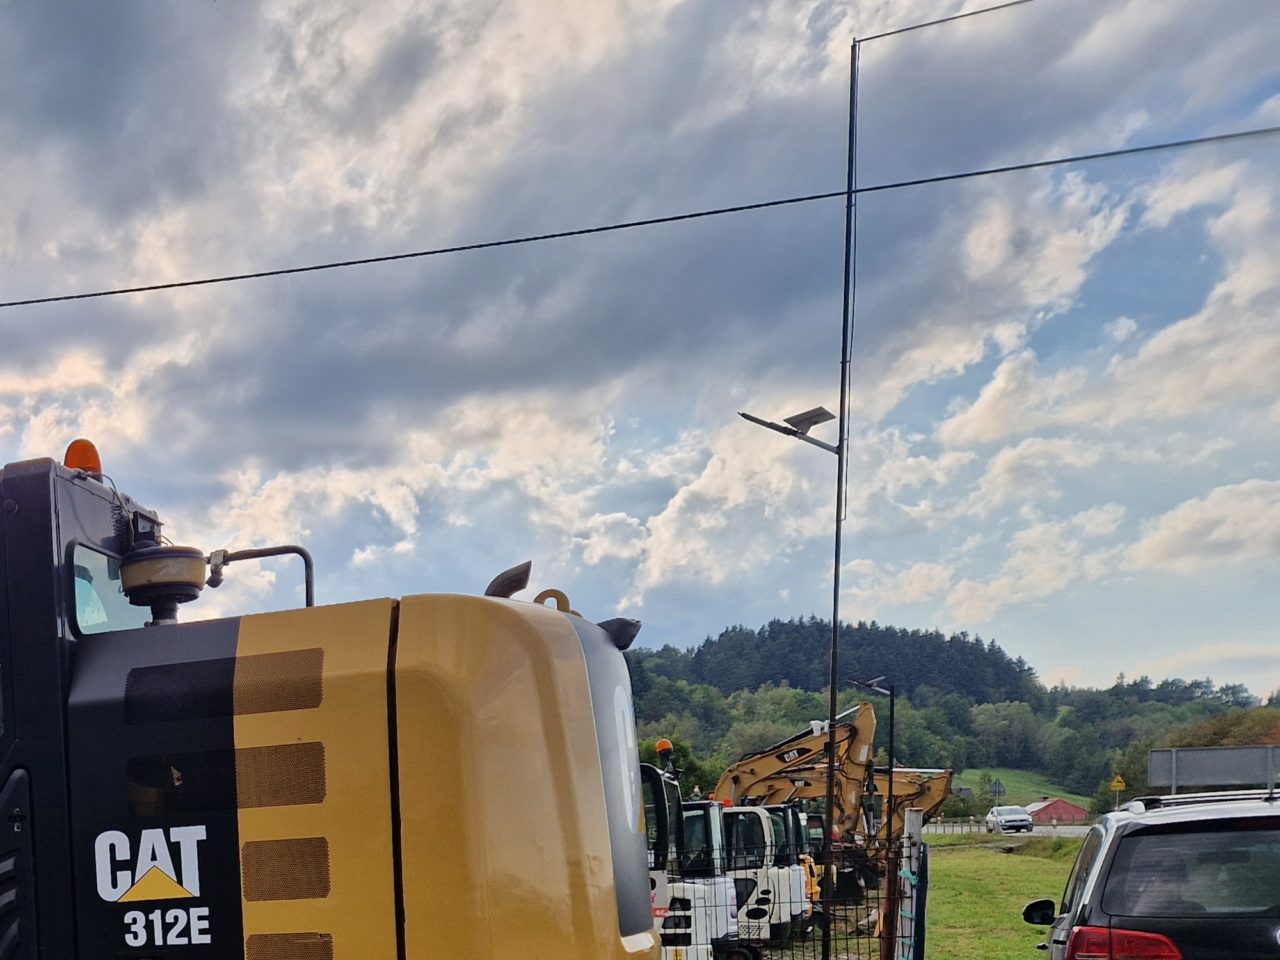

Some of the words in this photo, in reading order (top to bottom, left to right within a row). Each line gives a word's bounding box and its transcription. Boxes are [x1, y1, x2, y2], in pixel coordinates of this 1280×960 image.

[784, 750, 799, 762] CAT
[94, 825, 207, 902] CAT
[123, 907, 212, 947] 312E
